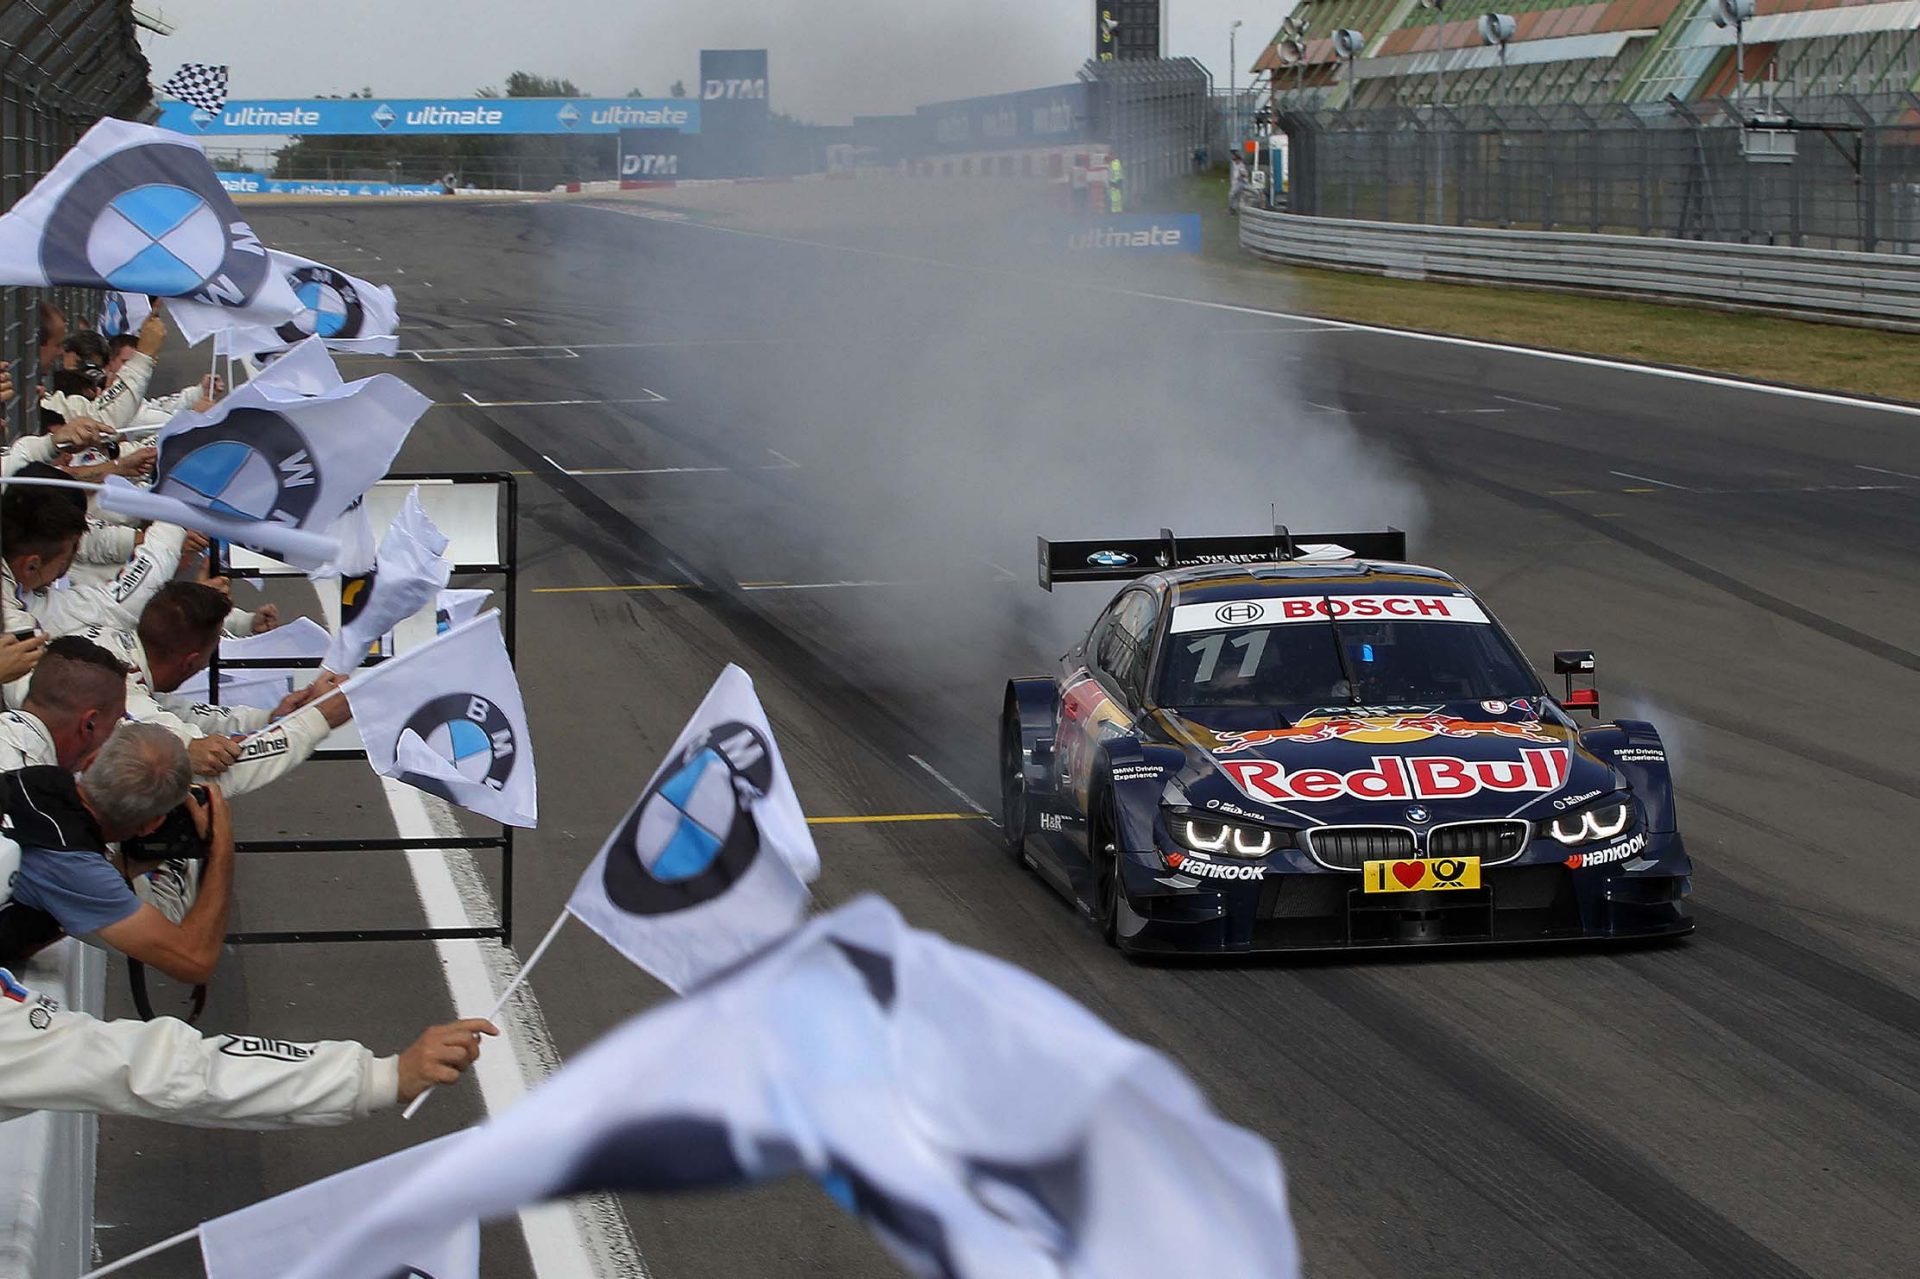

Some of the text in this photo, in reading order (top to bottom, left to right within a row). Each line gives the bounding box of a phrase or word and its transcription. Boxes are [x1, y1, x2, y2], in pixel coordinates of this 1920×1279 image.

[703, 79, 764, 99] DTM
[224, 107, 320, 126] ultimate
[406, 106, 503, 125] ultimate
[591, 105, 688, 125] ultimate
[621, 154, 678, 175] DTM
[1069, 225, 1181, 249] ultimate
[1282, 598, 1451, 619] BOSCH
[1187, 630, 1271, 684] 11
[1636, 748, 1664, 756] Driving
[1112, 765, 1164, 775] BMW Driving
[1113, 772, 1159, 781] Experience
[1218, 749, 1567, 800] Red Bull
[1378, 862, 1386, 890] I
